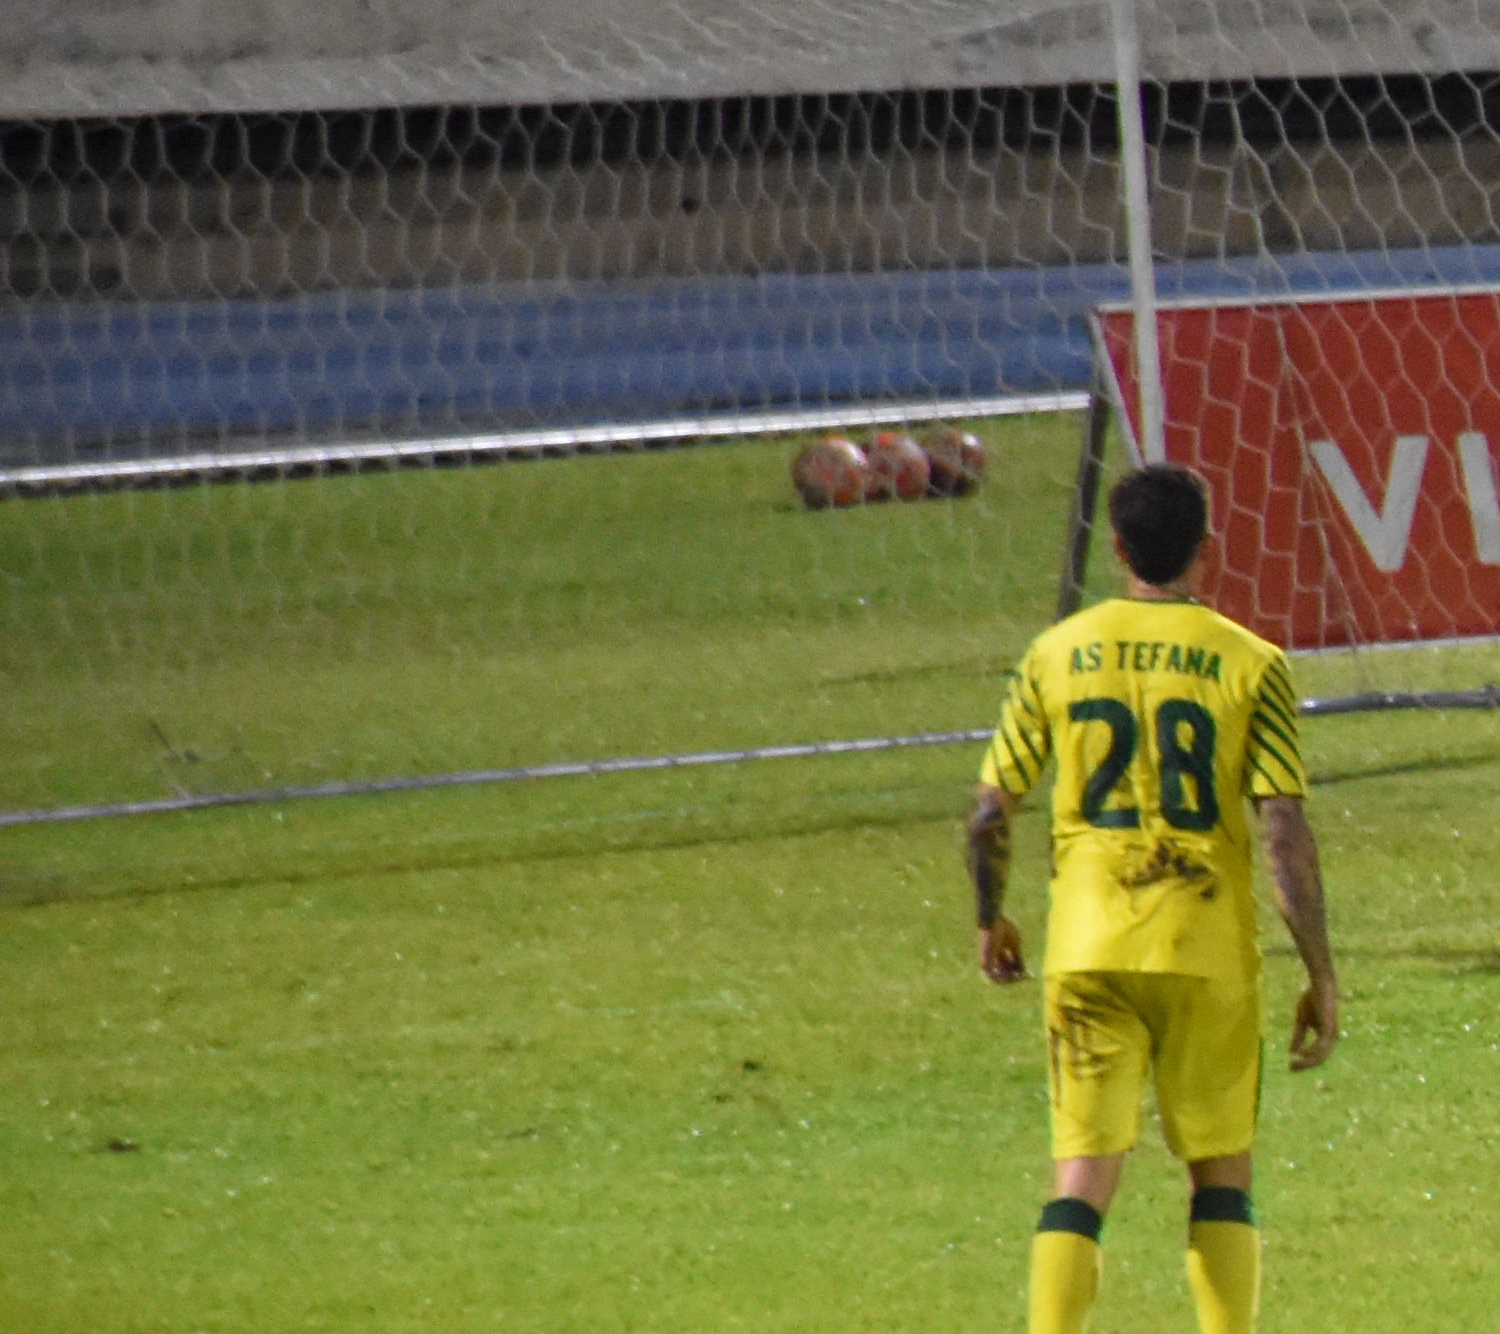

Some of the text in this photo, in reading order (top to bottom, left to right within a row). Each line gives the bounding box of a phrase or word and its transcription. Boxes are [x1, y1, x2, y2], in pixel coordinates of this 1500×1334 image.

[1069, 640, 1222, 683] AS TEFANA
[1068, 697, 1221, 832] 28
